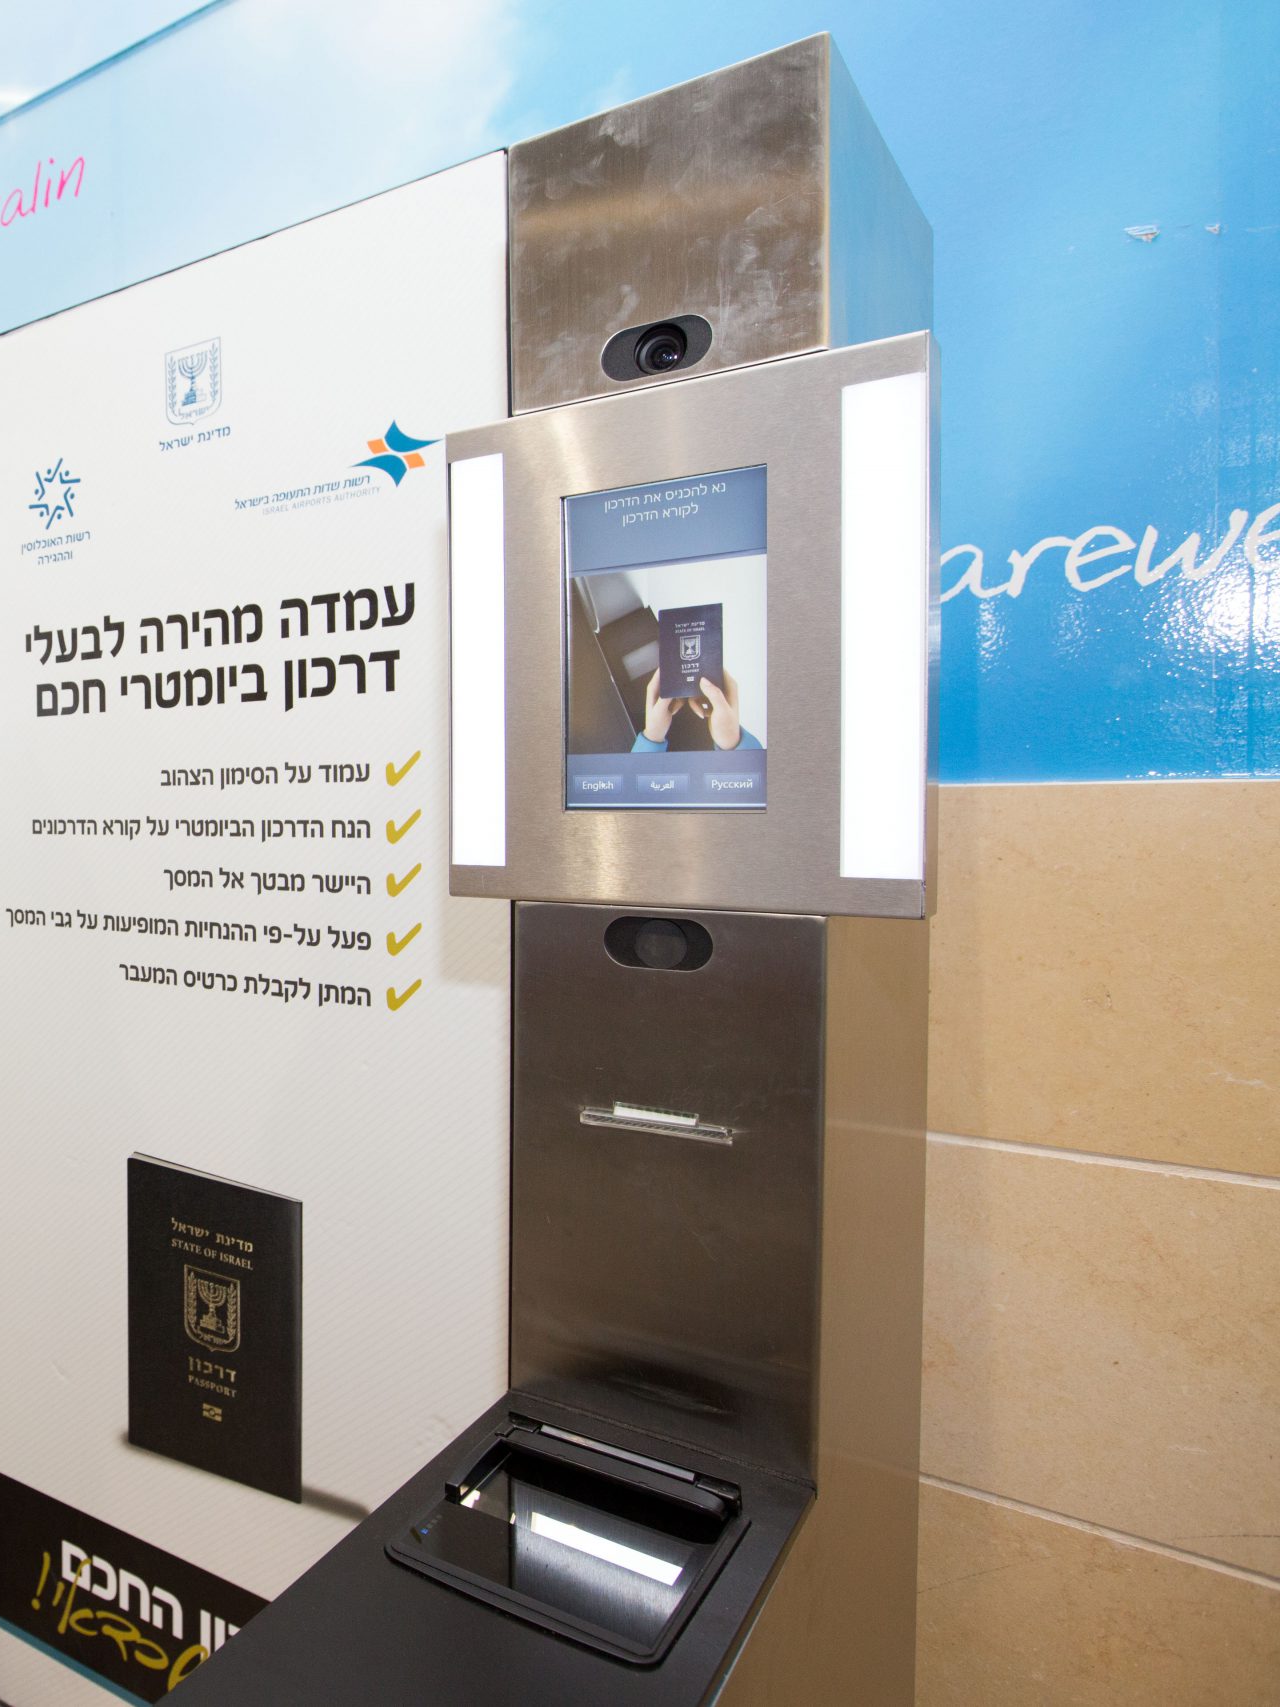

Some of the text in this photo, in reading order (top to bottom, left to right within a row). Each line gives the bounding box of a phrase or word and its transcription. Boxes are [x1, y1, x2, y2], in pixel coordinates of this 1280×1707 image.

[159, 425, 231, 452] מדינת ישראל
[234, 475, 370, 510] רשות שדות התעופה בישראל
[262, 487, 381, 515] ISRAEL AIRPORTS AUTHORITY
[604, 482, 726, 512] נא להכניס את הדרכון
[622, 502, 699, 527] לקורא הדרכון
[21, 531, 91, 555] רשות האוכלוסין
[38, 550, 73, 565] וההגירה
[24, 582, 416, 666] עמדה מהירה לבעלי
[36, 649, 400, 717] דרכון ביומטרי חכם
[161, 762, 370, 790] עמוד על הסימון הצהוב
[582, 779, 614, 792] English
[650, 778, 675, 792] العربية
[711, 778, 753, 791] Русский
[32, 816, 370, 843] הנח הדרכון הביומטרי על קורא הדרכונים
[164, 868, 370, 896] היישר מבטך אל המסך
[6, 908, 371, 950] פעל על-פי ההנחיות המופיעות על גבי המסך
[120, 963, 371, 1007] המתן לקבלת כרטיס המעבר
[171, 1217, 254, 1253] מדינת ישראל
[171, 1238, 254, 1270] STATE OF ISRAEL
[188, 1356, 237, 1383] דרכון
[188, 1374, 237, 1398] PASSPORT
[61, 1540, 183, 1640] החכם
